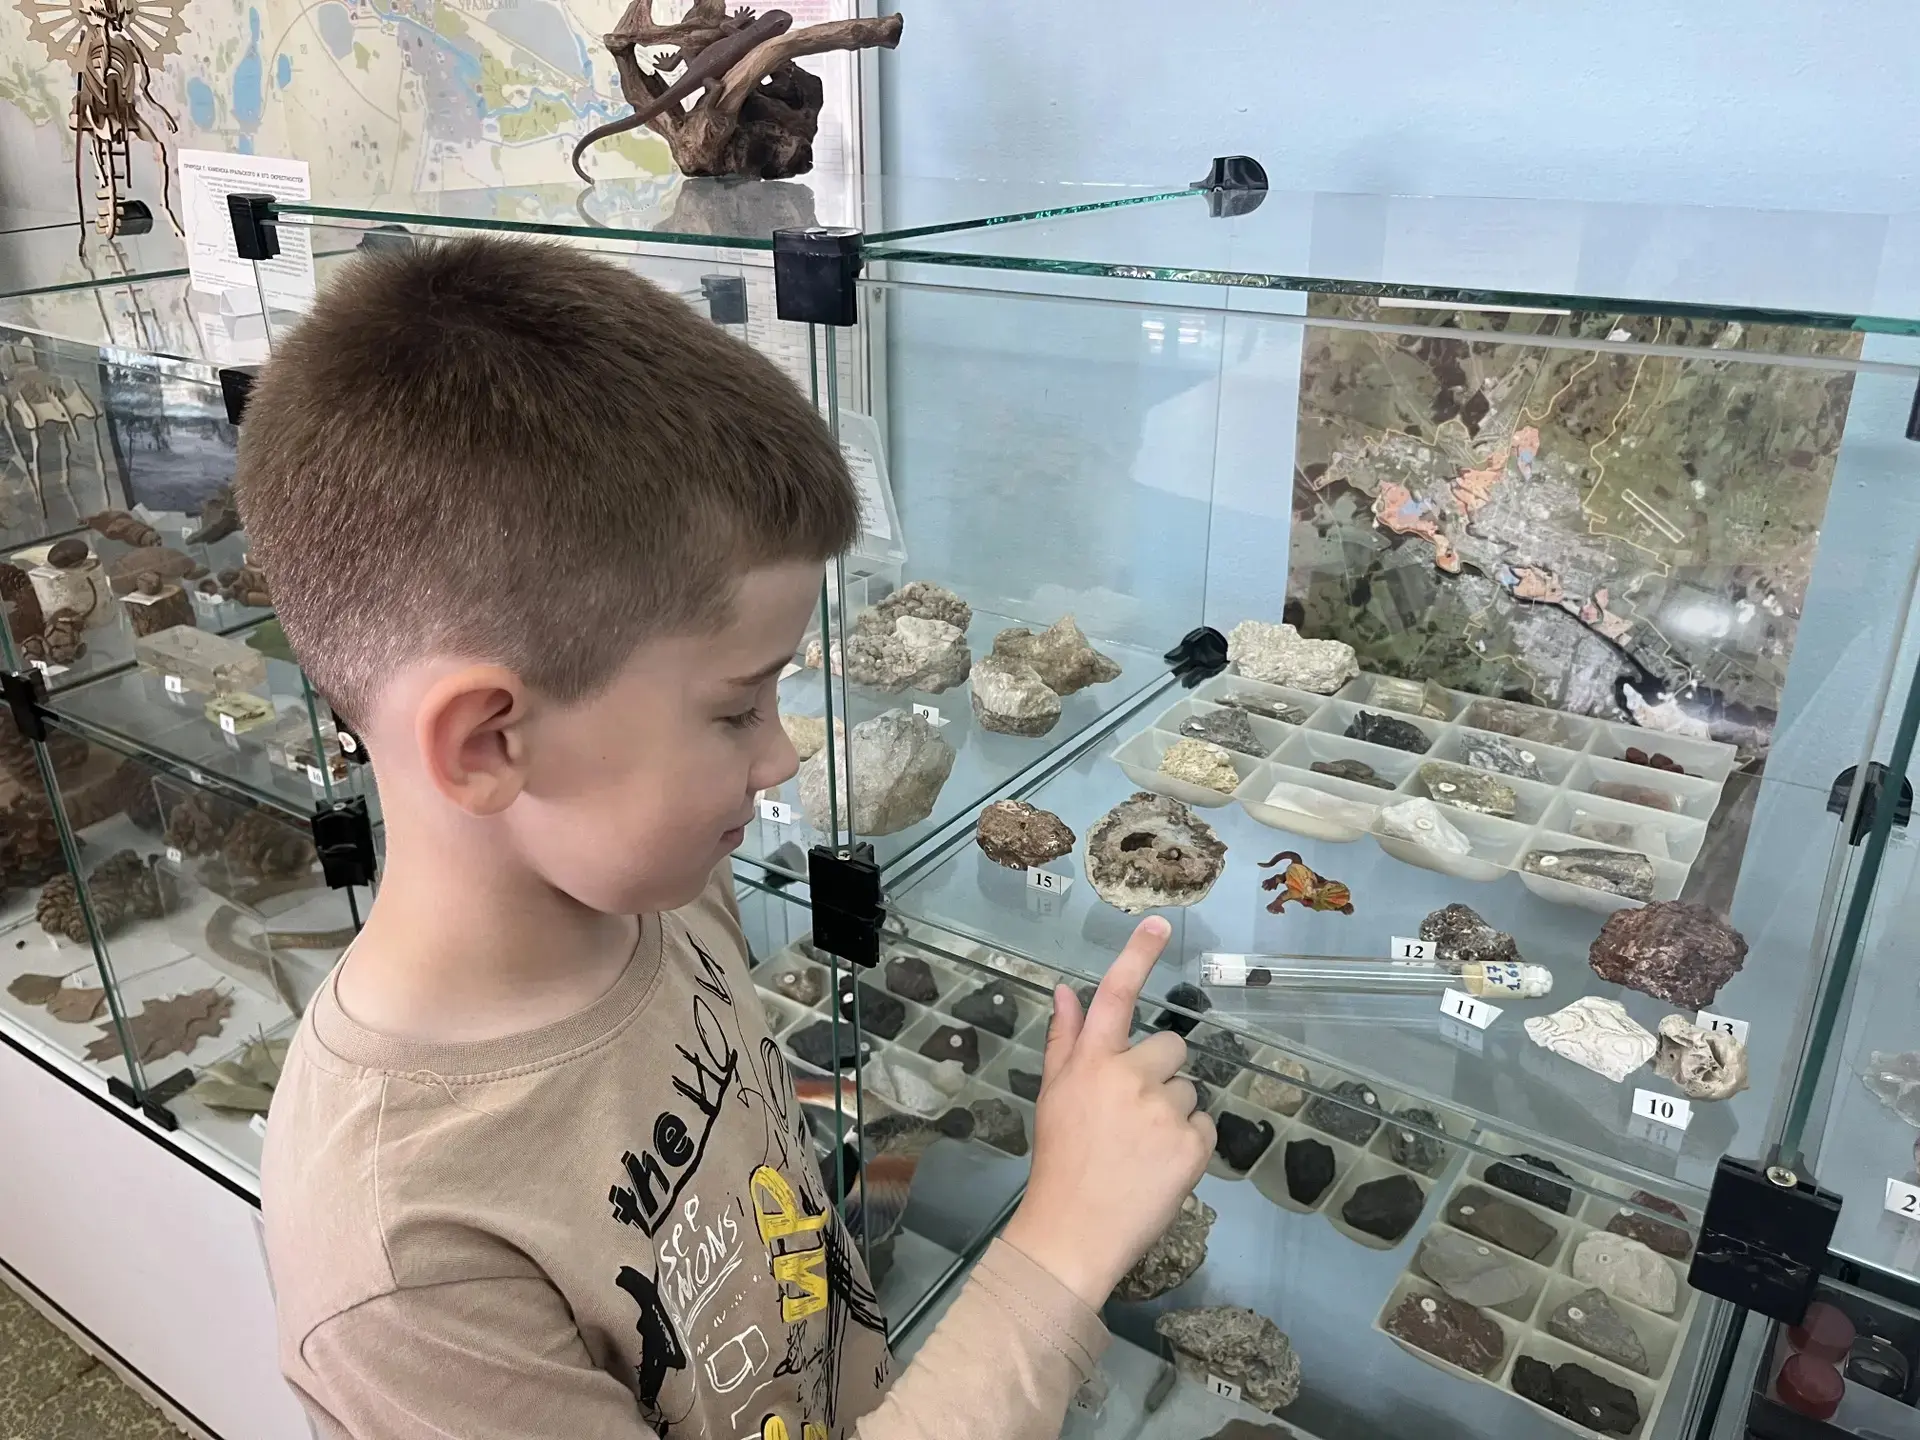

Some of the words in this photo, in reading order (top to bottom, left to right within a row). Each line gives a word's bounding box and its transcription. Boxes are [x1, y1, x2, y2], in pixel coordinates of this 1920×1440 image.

[772, 806, 780, 818] 8
[1036, 873, 1052, 888] 15
[1404, 944, 1424, 959] 12
[1486, 965, 1502, 984] 17
[1456, 1000, 1475, 1020] 11
[1649, 1098, 1674, 1119] 10
[608, 1111, 695, 1240] the
[1901, 1194, 1920, 1215] 2
[1217, 1382, 1232, 1396] 17
